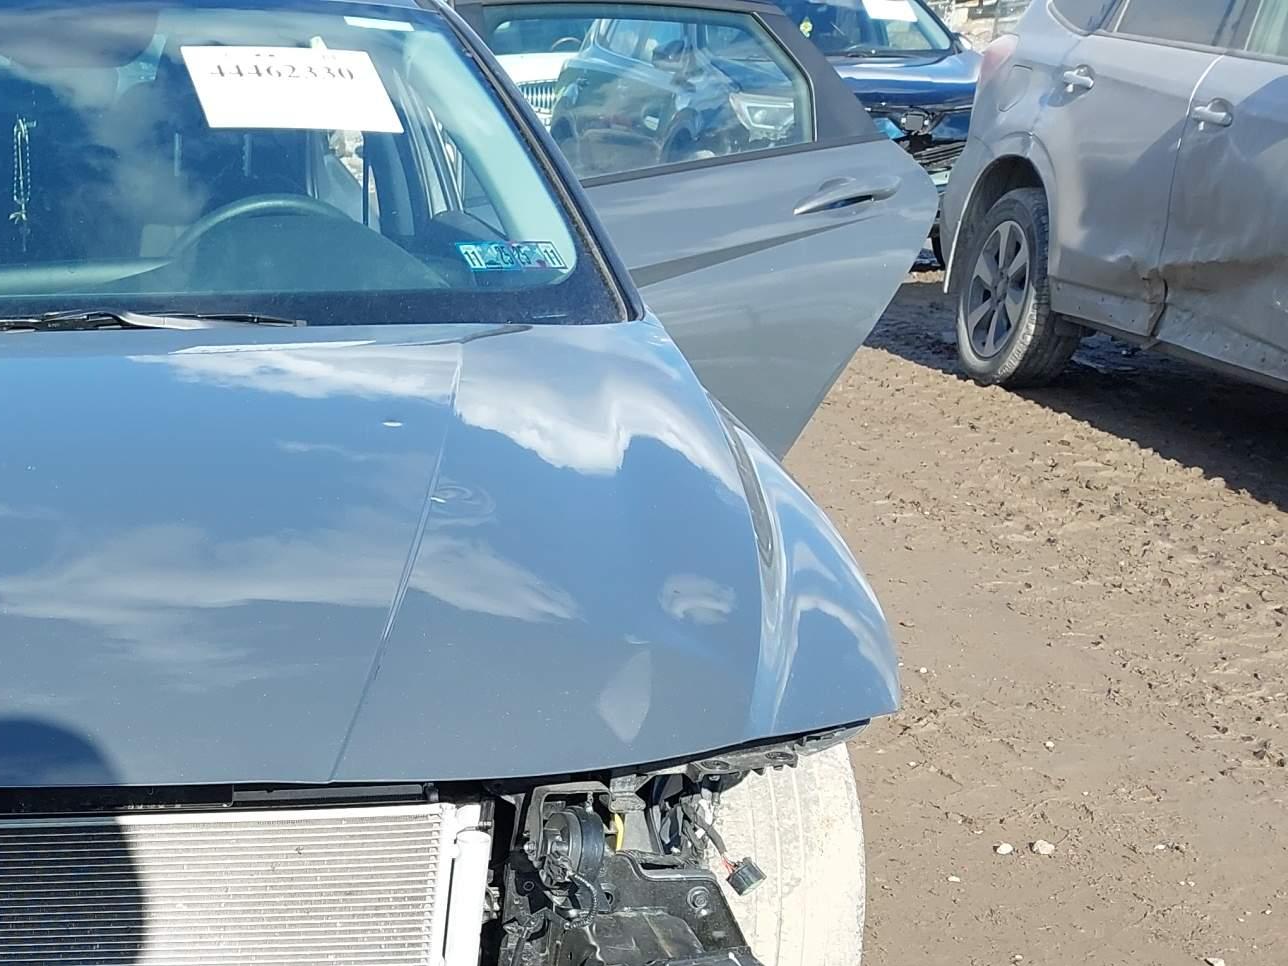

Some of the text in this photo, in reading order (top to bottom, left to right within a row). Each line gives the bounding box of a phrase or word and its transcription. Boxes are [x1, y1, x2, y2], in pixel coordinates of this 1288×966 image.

[209, 63, 355, 80] 44462330
[464, 250, 484, 267] 11
[543, 249, 563, 266] 11
